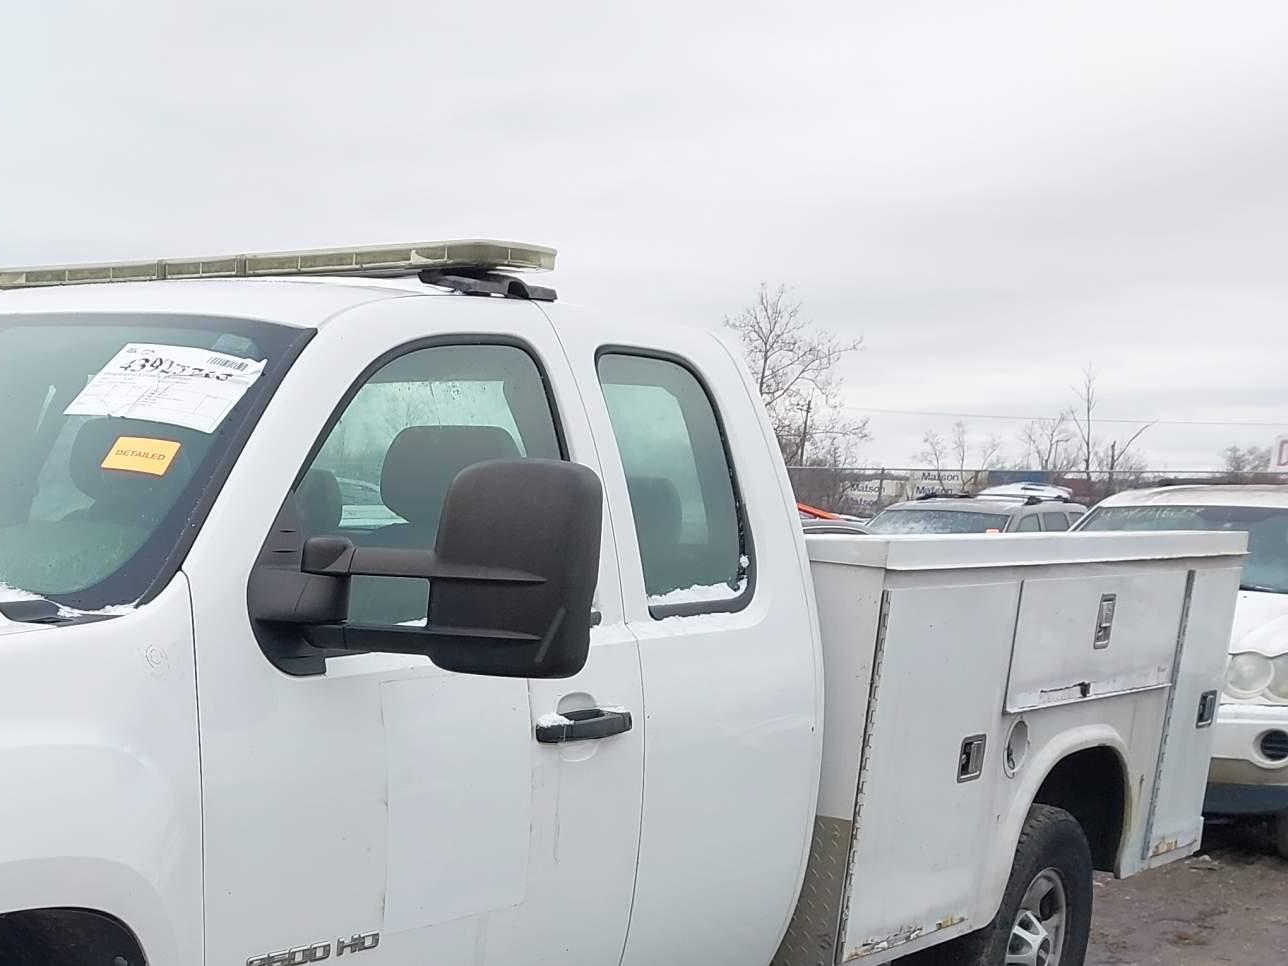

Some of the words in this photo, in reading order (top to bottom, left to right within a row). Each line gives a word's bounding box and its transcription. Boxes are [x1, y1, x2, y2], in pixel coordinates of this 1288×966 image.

[115, 449, 166, 461] DETAILED
[921, 472, 959, 482] Matson
[336, 930, 380, 956] HD
